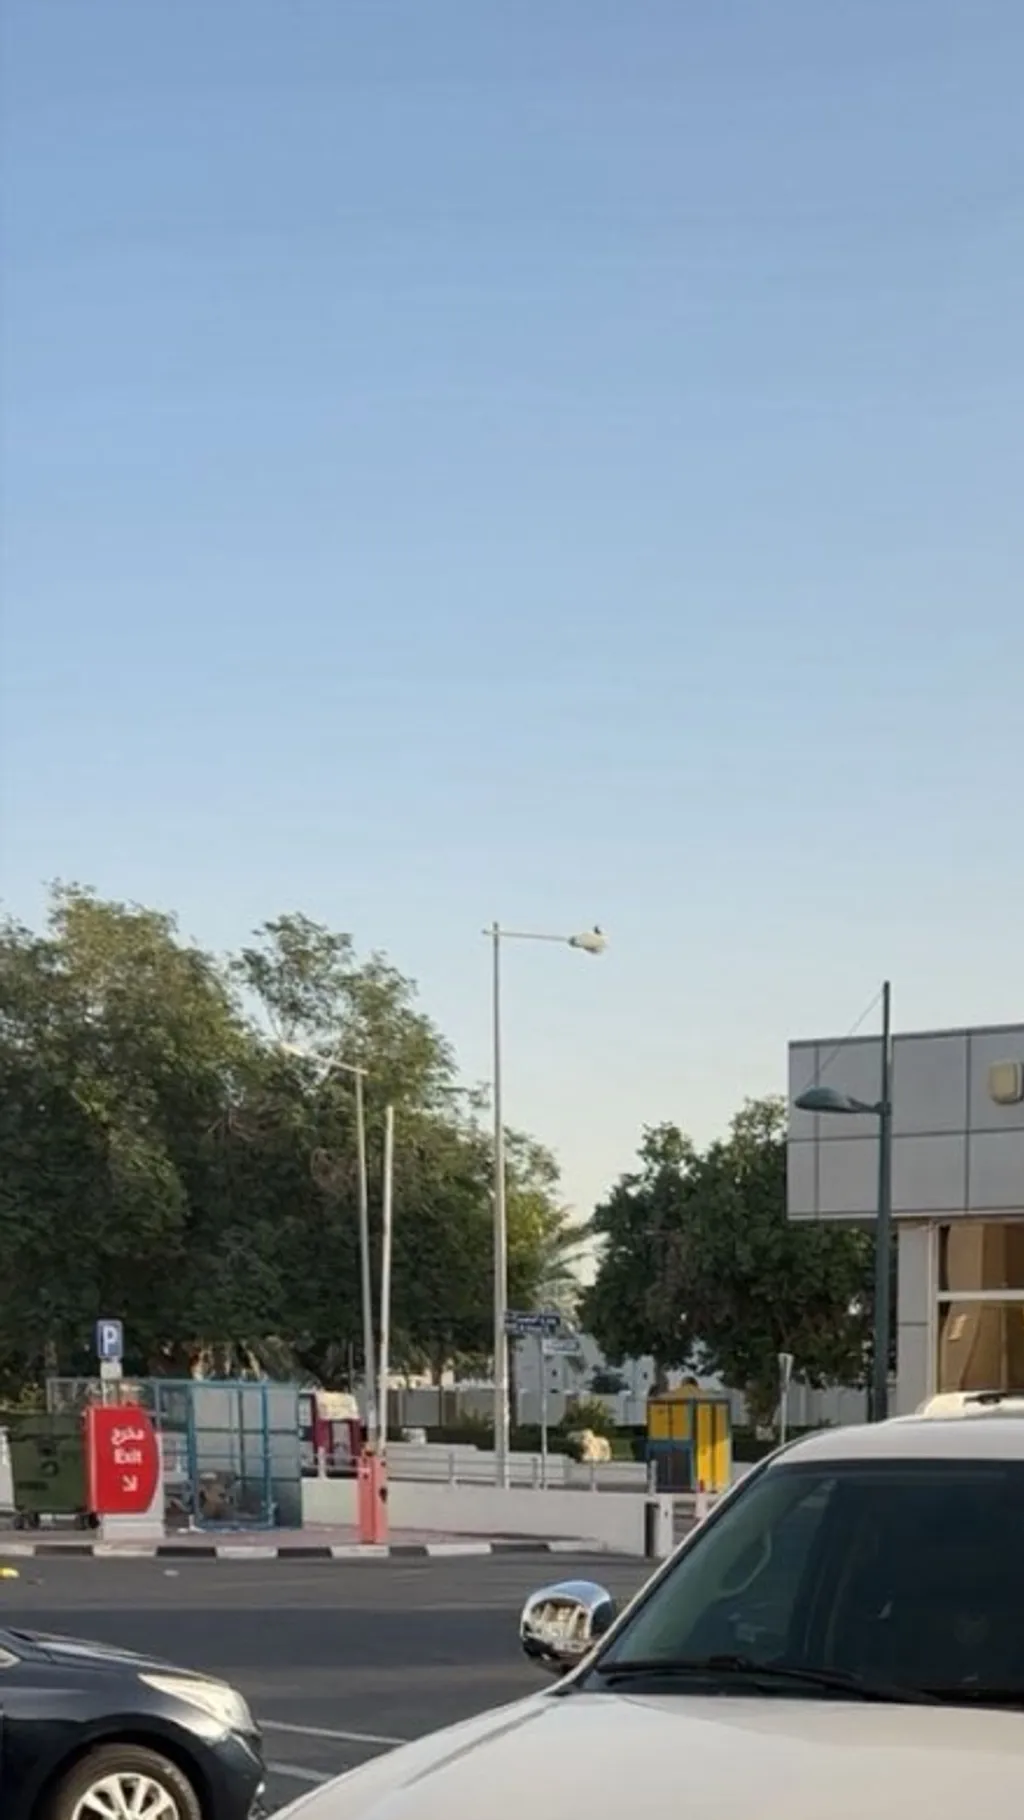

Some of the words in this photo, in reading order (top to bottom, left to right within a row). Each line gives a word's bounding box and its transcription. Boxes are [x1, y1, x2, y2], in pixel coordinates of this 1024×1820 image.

[103, 1326, 117, 1354] P
[111, 1426, 145, 1446] مخرج
[113, 1448, 142, 1465] Exit
